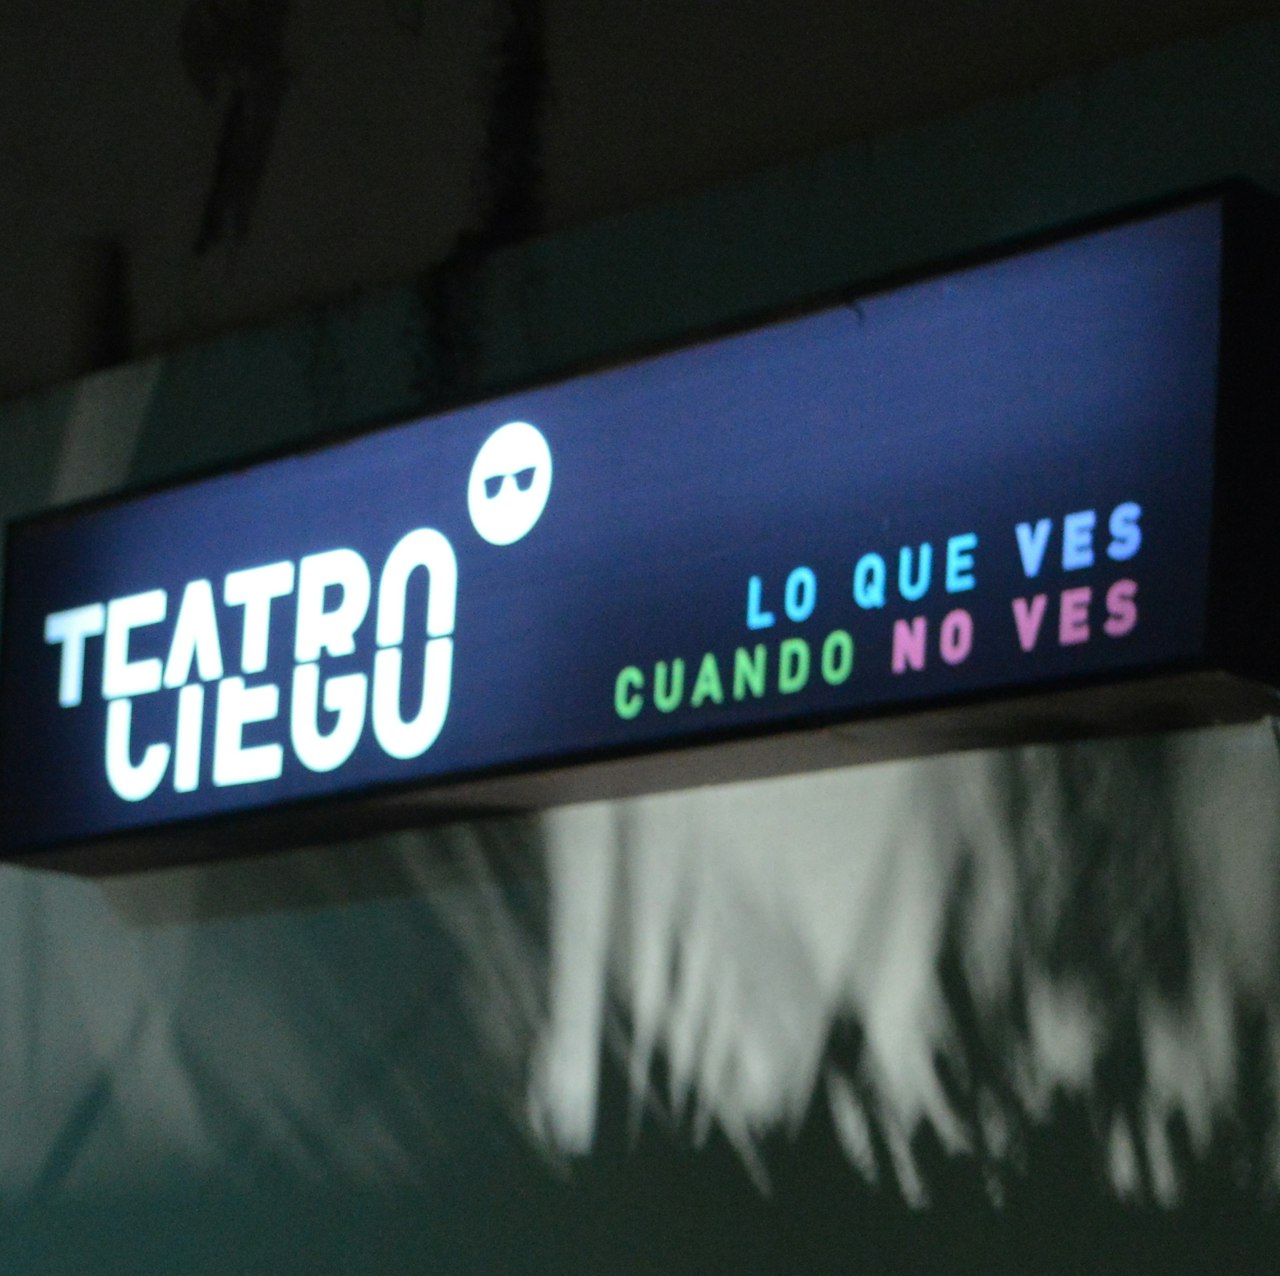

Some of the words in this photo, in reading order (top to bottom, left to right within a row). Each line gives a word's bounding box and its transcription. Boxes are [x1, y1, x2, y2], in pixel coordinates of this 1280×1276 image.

[44, 527, 458, 708] TEATRO
[747, 566, 816, 630] LO
[853, 532, 978, 610] QUE
[1015, 501, 1142, 577] VES
[105, 636, 454, 802] CIEGO
[615, 630, 854, 719] CUANDO
[892, 609, 973, 674] NO
[1012, 579, 1138, 651] VES
